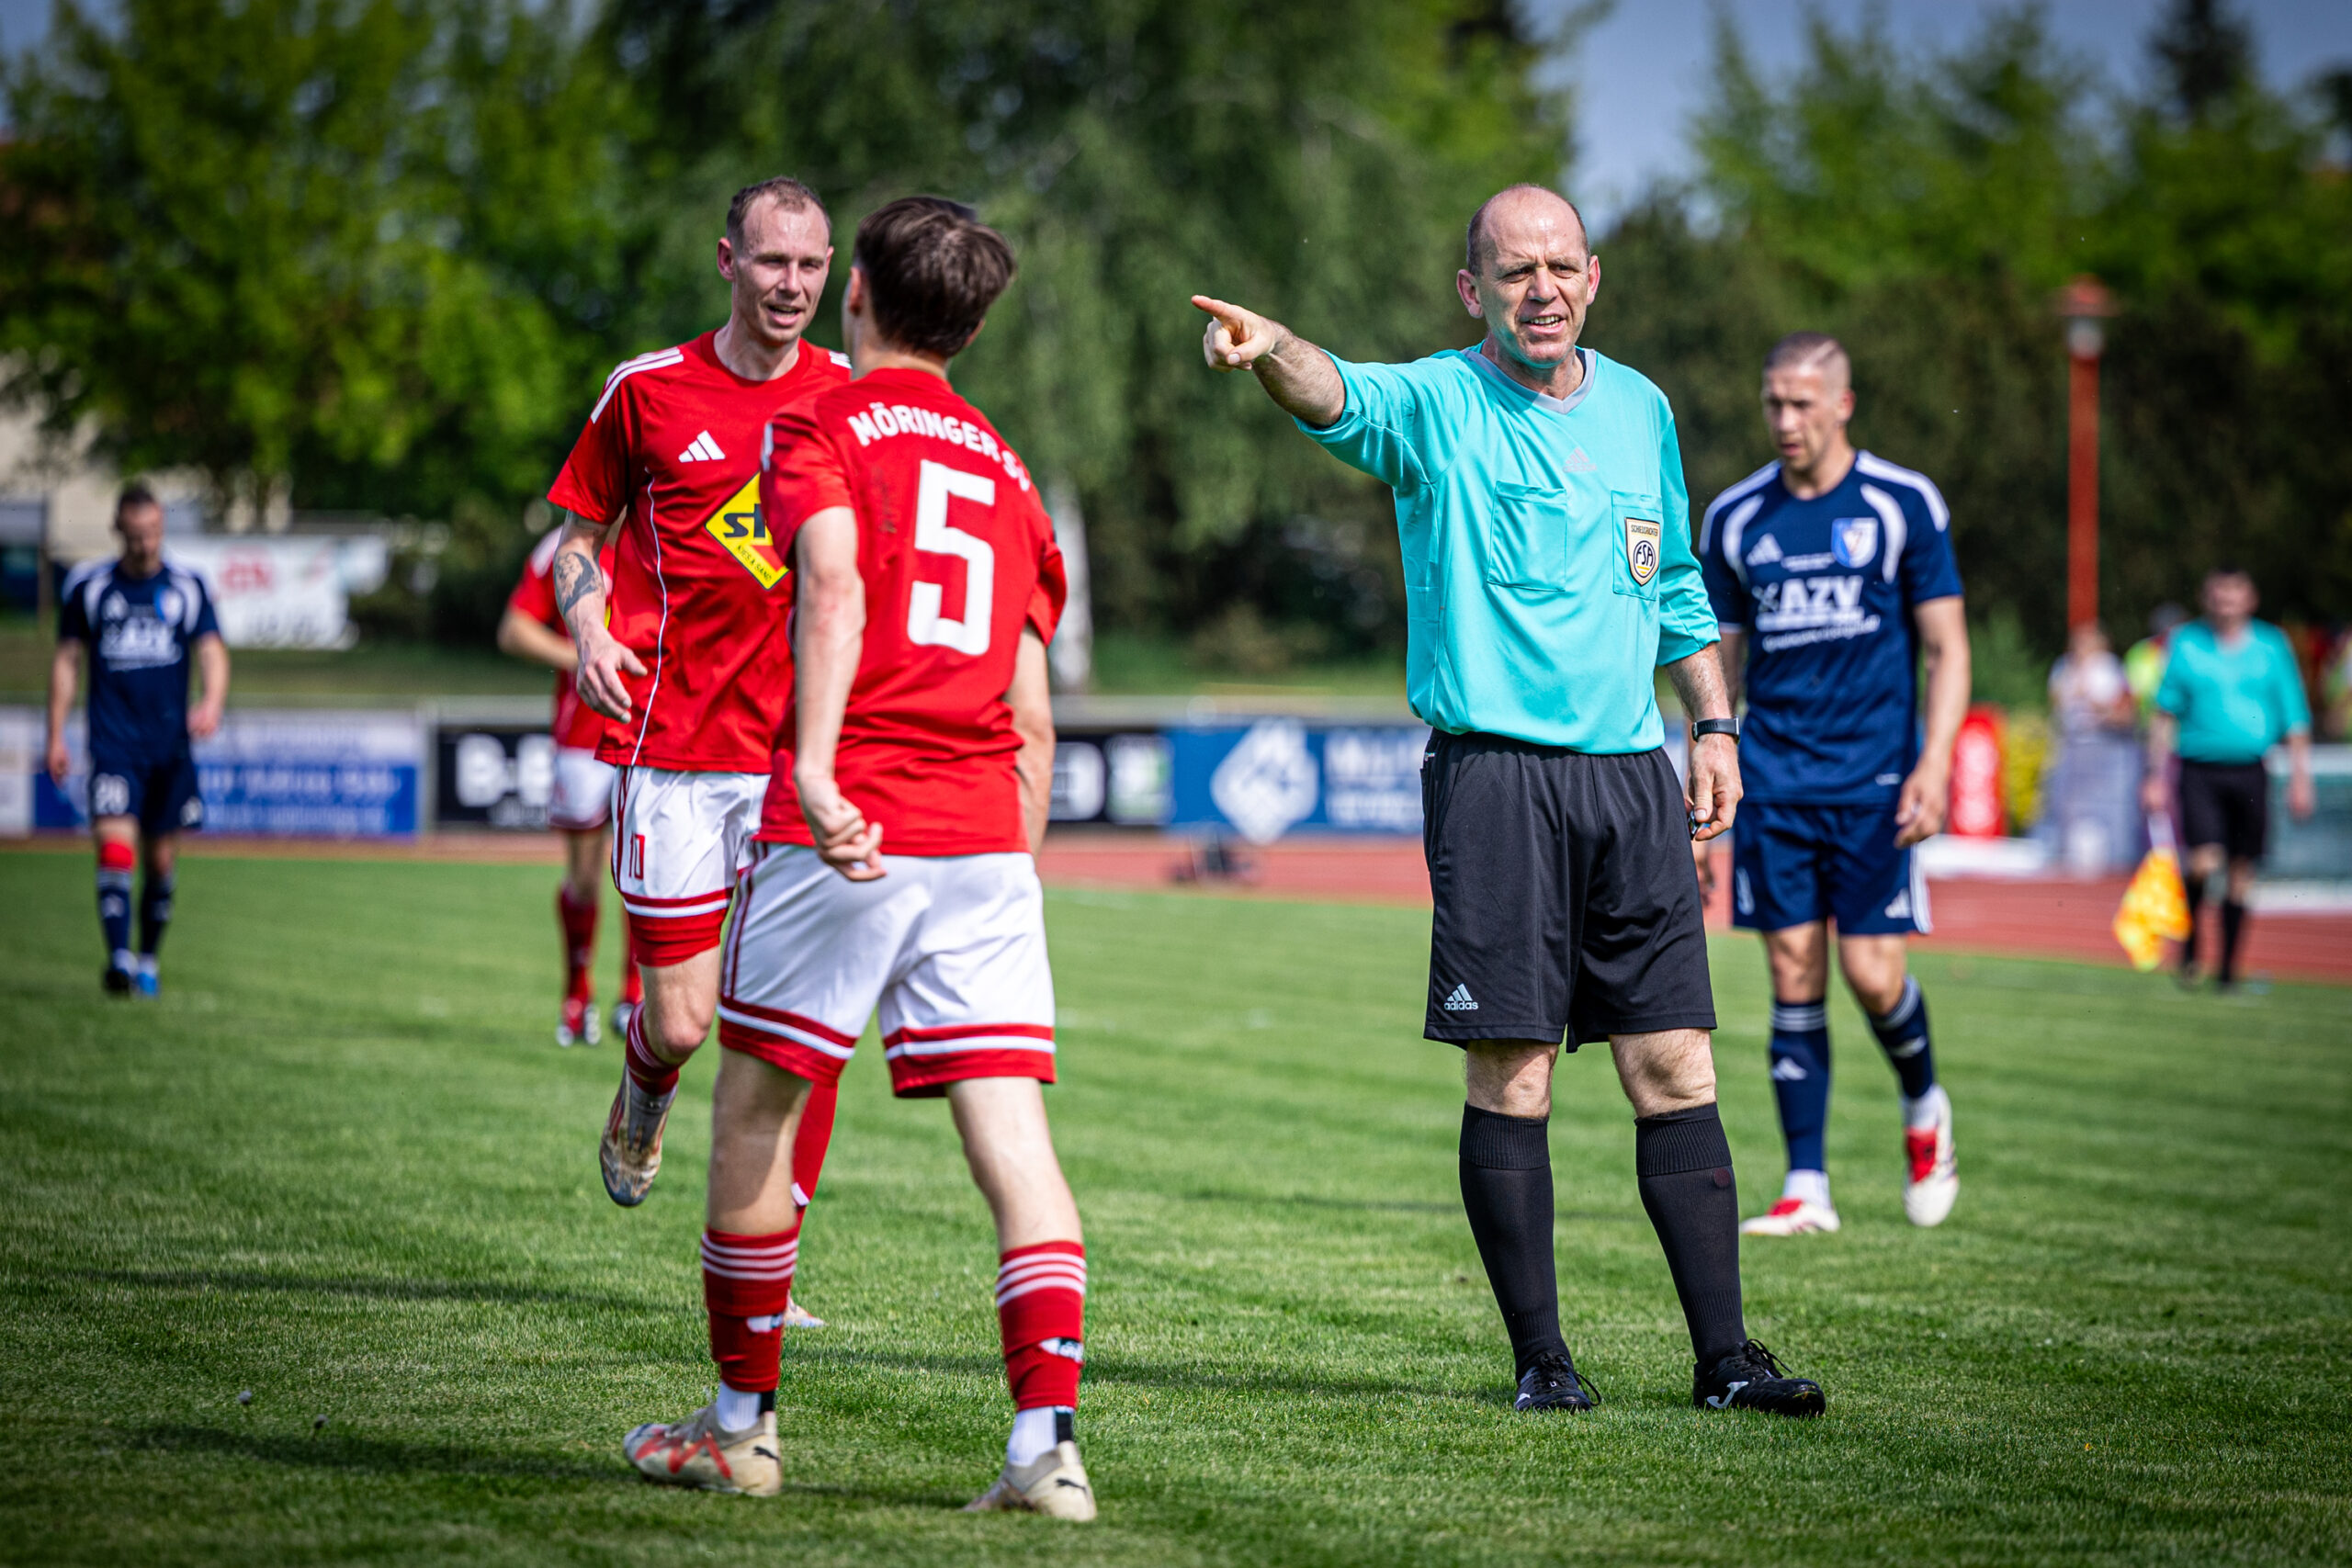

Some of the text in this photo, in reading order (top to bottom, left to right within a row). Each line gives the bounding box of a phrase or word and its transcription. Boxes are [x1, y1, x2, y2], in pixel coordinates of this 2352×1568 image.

[847, 401, 1001, 463] MÖRINGER
[907, 458, 996, 657] 5
[1635, 544, 1655, 568] FSA
[1779, 575, 1864, 613] AZV
[628, 831, 646, 881] 10
[1443, 1000, 1479, 1011] adidas
